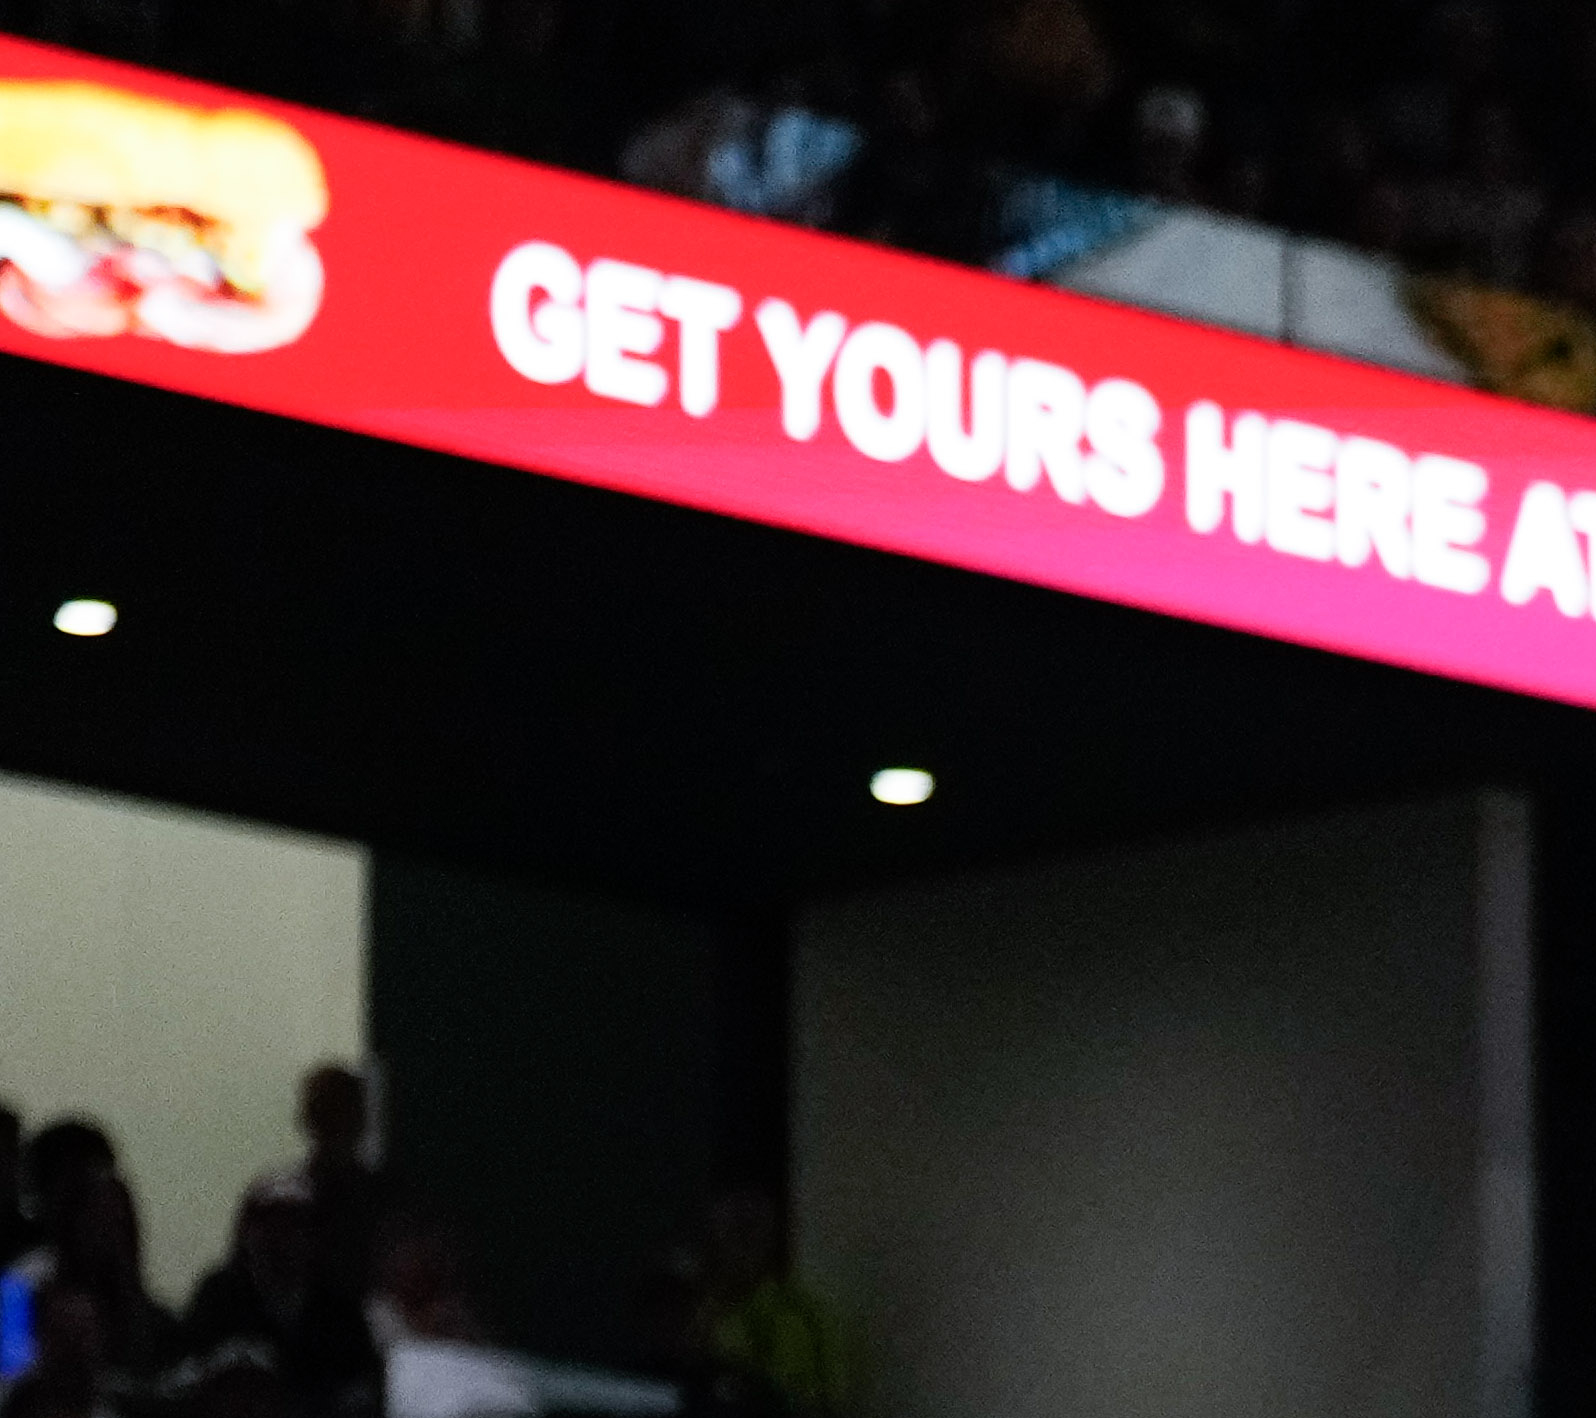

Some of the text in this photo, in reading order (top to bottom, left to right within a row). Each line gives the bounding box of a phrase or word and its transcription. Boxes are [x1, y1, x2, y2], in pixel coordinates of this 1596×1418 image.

[489, 239, 743, 418] GET
[754, 297, 1165, 518] YOURS
[1184, 398, 1491, 597] HERE
